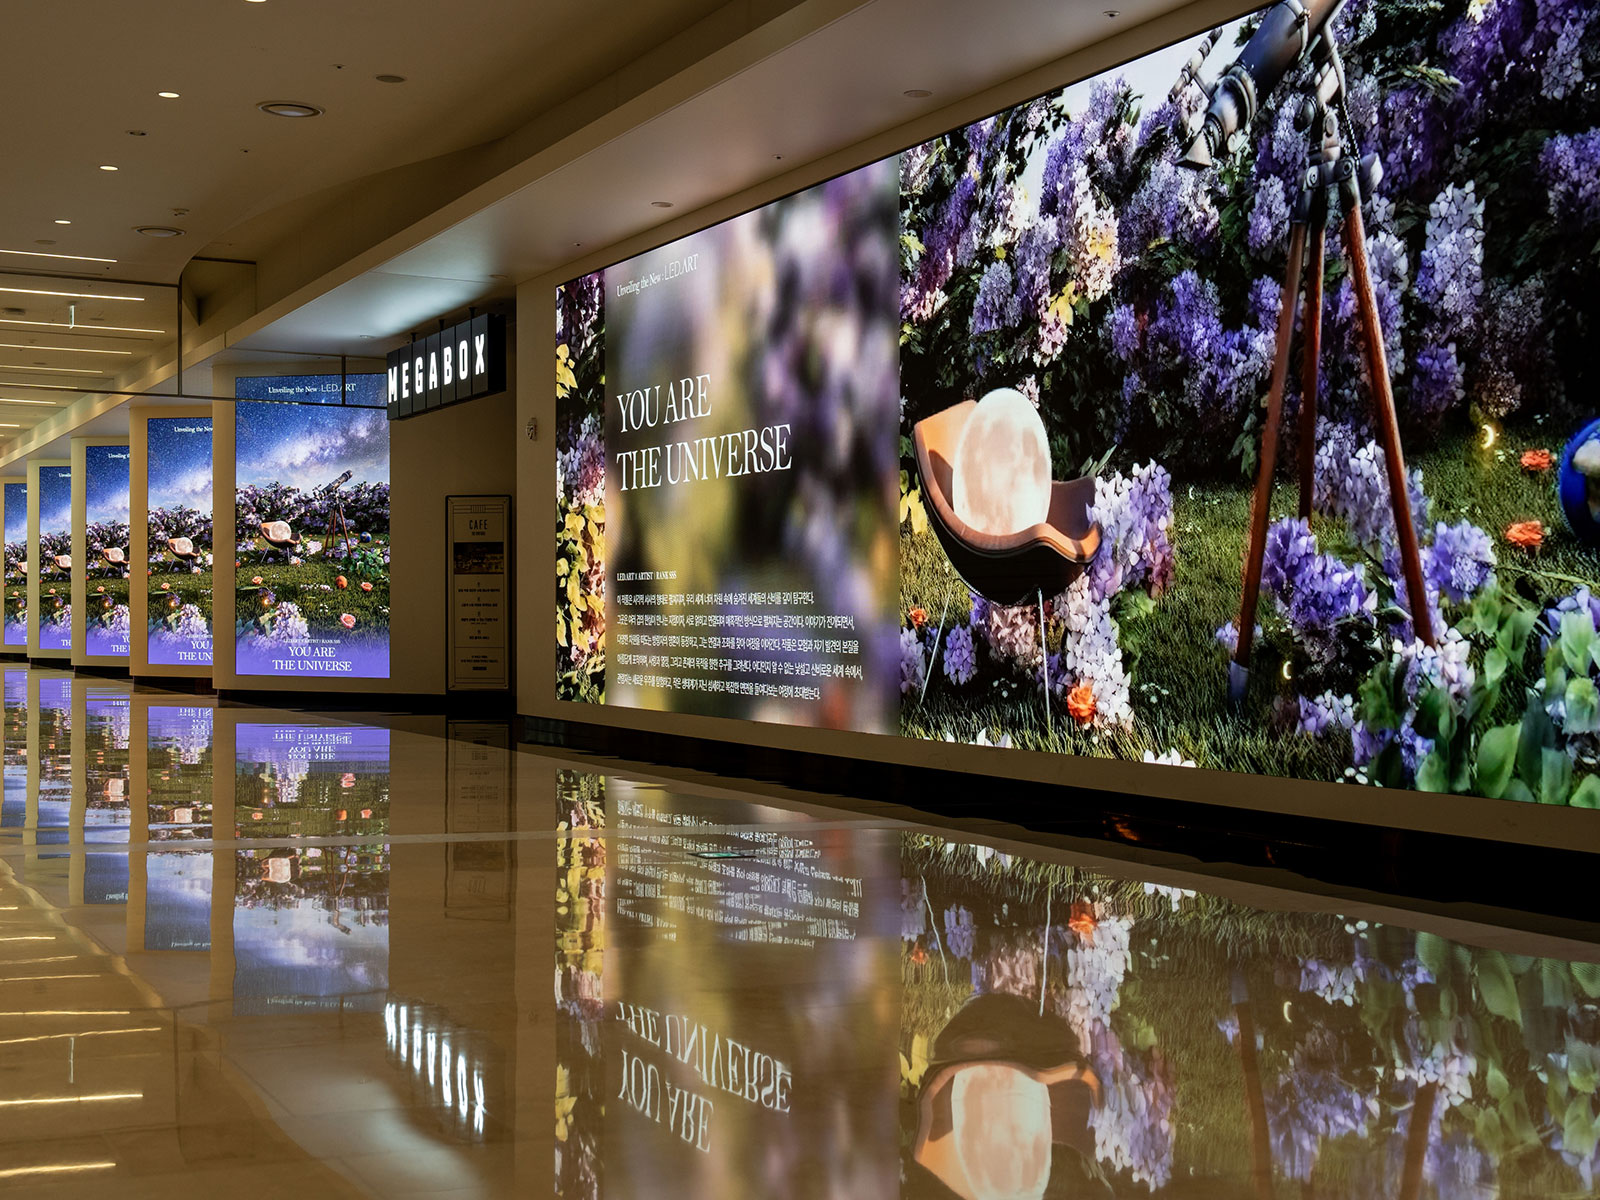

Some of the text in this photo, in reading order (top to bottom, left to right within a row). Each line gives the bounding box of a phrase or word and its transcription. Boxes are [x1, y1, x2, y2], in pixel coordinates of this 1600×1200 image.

[616, 280, 640, 297] Unveiling
[640, 276, 649, 288] the
[388, 333, 485, 404] MEGABOX
[268, 386, 294, 394] Unveiling
[616, 374, 712, 433] YOU ARE
[616, 424, 792, 492] THE UNIVERSE
[469, 520, 488, 530] CAFE
[111, 644, 128, 652] THE
[191, 640, 209, 650] YOU
[177, 651, 197, 660] THE
[288, 646, 336, 657] YOU ARE
[272, 660, 352, 672] THE UNIVERSE
